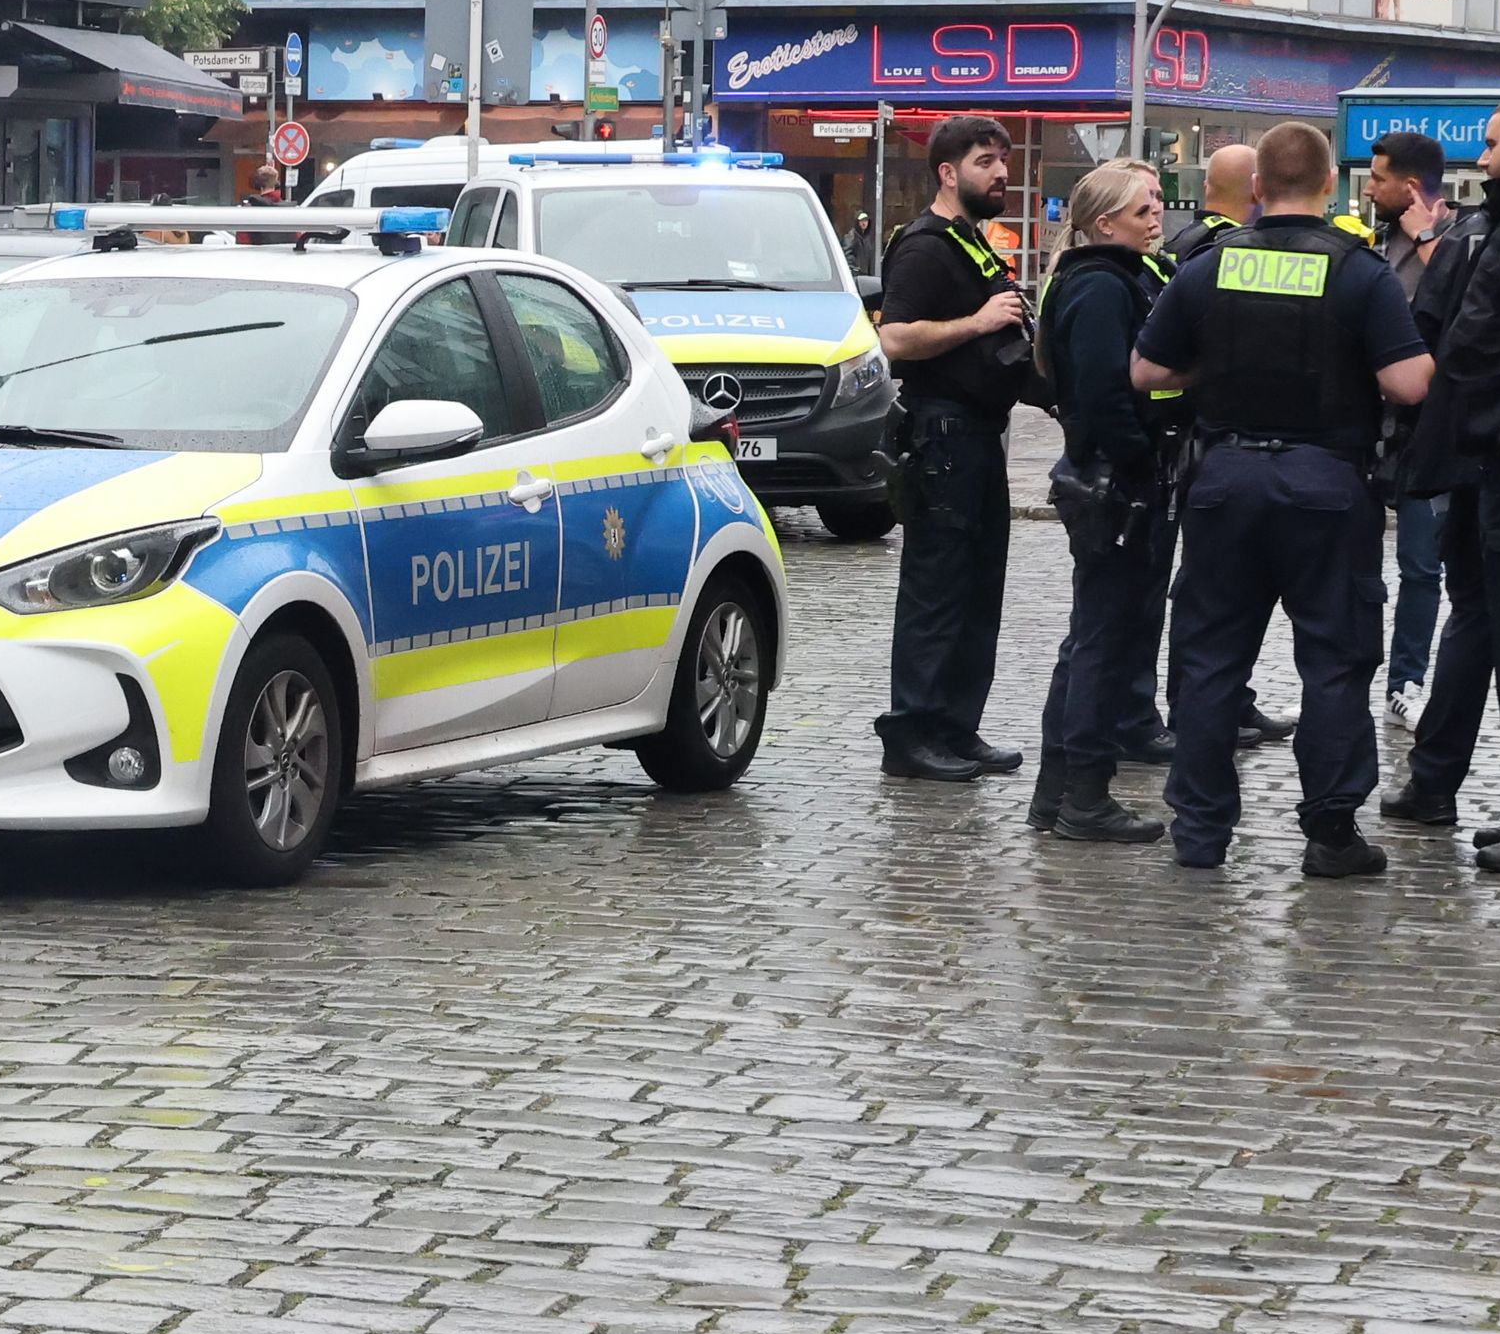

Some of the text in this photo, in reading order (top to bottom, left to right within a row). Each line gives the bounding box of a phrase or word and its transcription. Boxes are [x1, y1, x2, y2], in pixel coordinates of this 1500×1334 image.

[592, 27, 604, 48] 30
[193, 54, 238, 67] Potsdamer
[726, 22, 859, 91] Eroticstore
[871, 22, 1083, 86] LSD
[1129, 27, 1211, 92] SD
[883, 66, 1069, 77] LOVE SEX DREAMS
[819, 126, 856, 134] Potsdamer
[1221, 251, 1326, 294] POLIZEI
[737, 440, 762, 458] 76
[410, 539, 532, 608] POLIZEI
